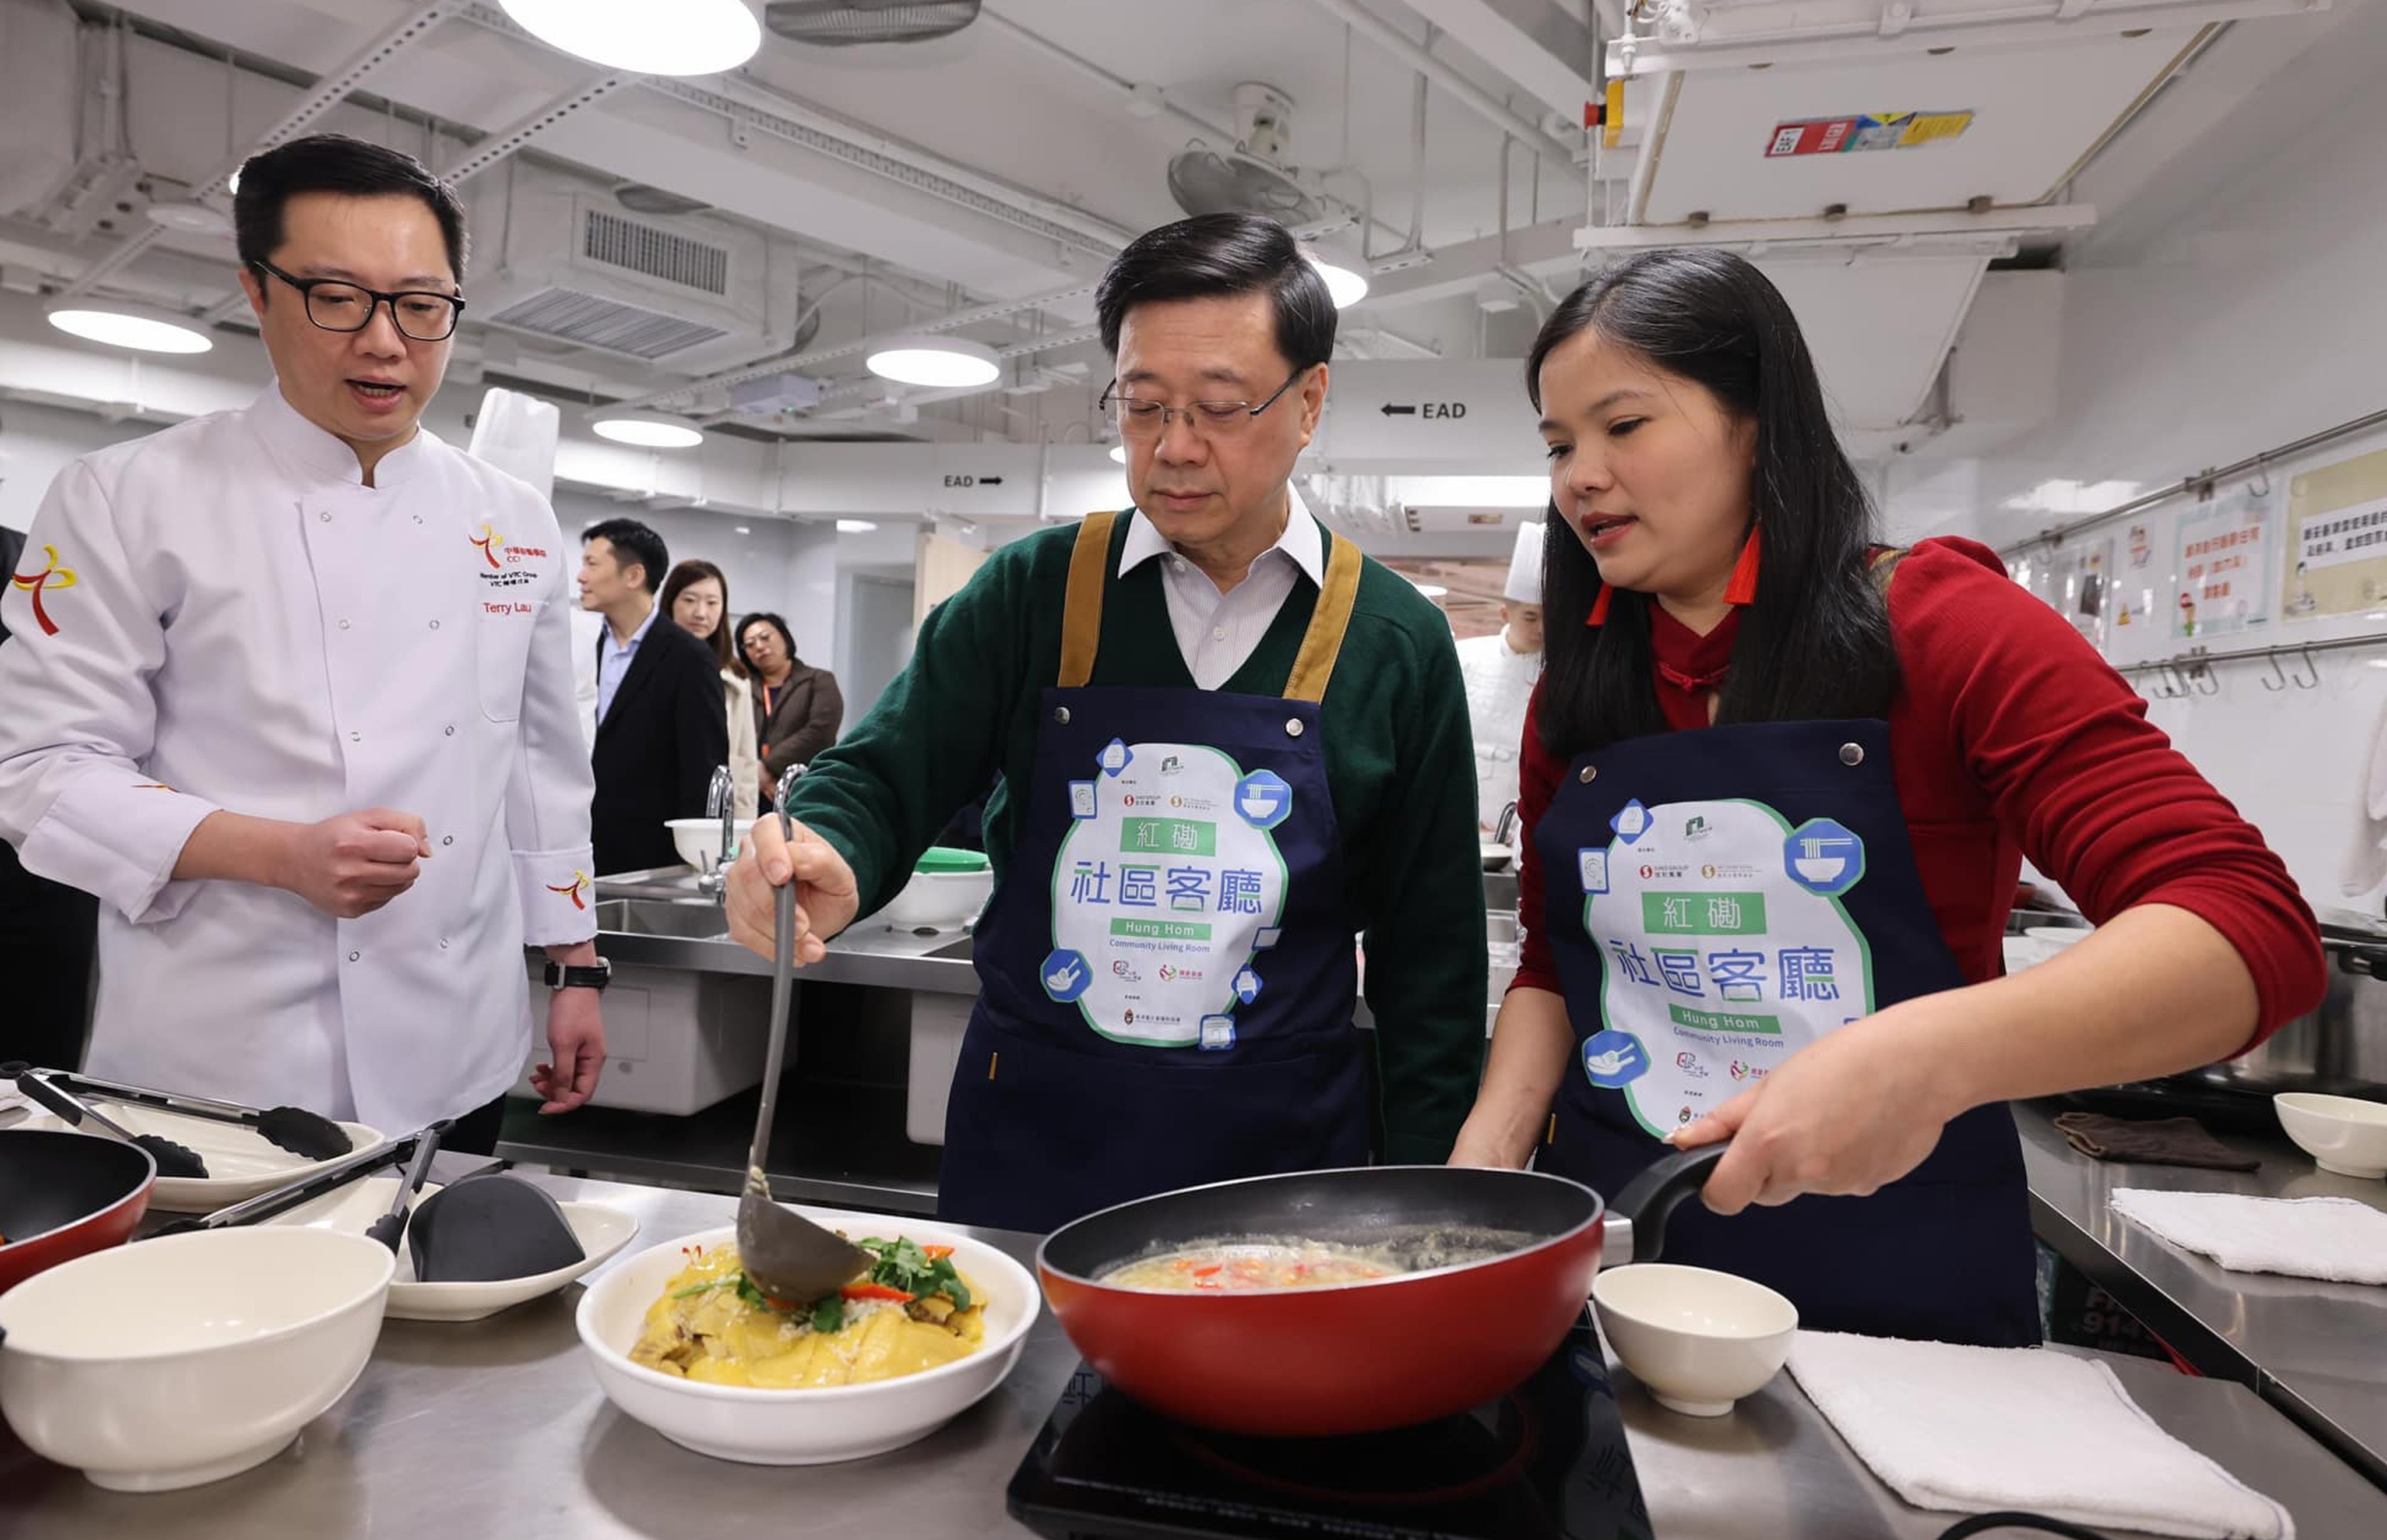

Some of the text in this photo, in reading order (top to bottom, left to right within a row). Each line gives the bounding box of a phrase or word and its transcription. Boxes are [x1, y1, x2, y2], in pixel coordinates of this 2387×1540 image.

[1423, 403, 1466, 418] EAD
[944, 475, 973, 488] EAD
[483, 602, 531, 615] Terry Lau
[1136, 822, 1198, 850] 紅磡
[1071, 861, 1263, 914] 社區客廳
[1662, 896, 1741, 929] 紅磡
[1125, 921, 1195, 937] Hung Hom
[1110, 938, 1210, 954] Community Living Room
[1609, 939, 1840, 1002] 社區客廳
[1682, 1011, 1760, 1030] Hung Hom
[1673, 1026, 1784, 1049] Community Living Room
